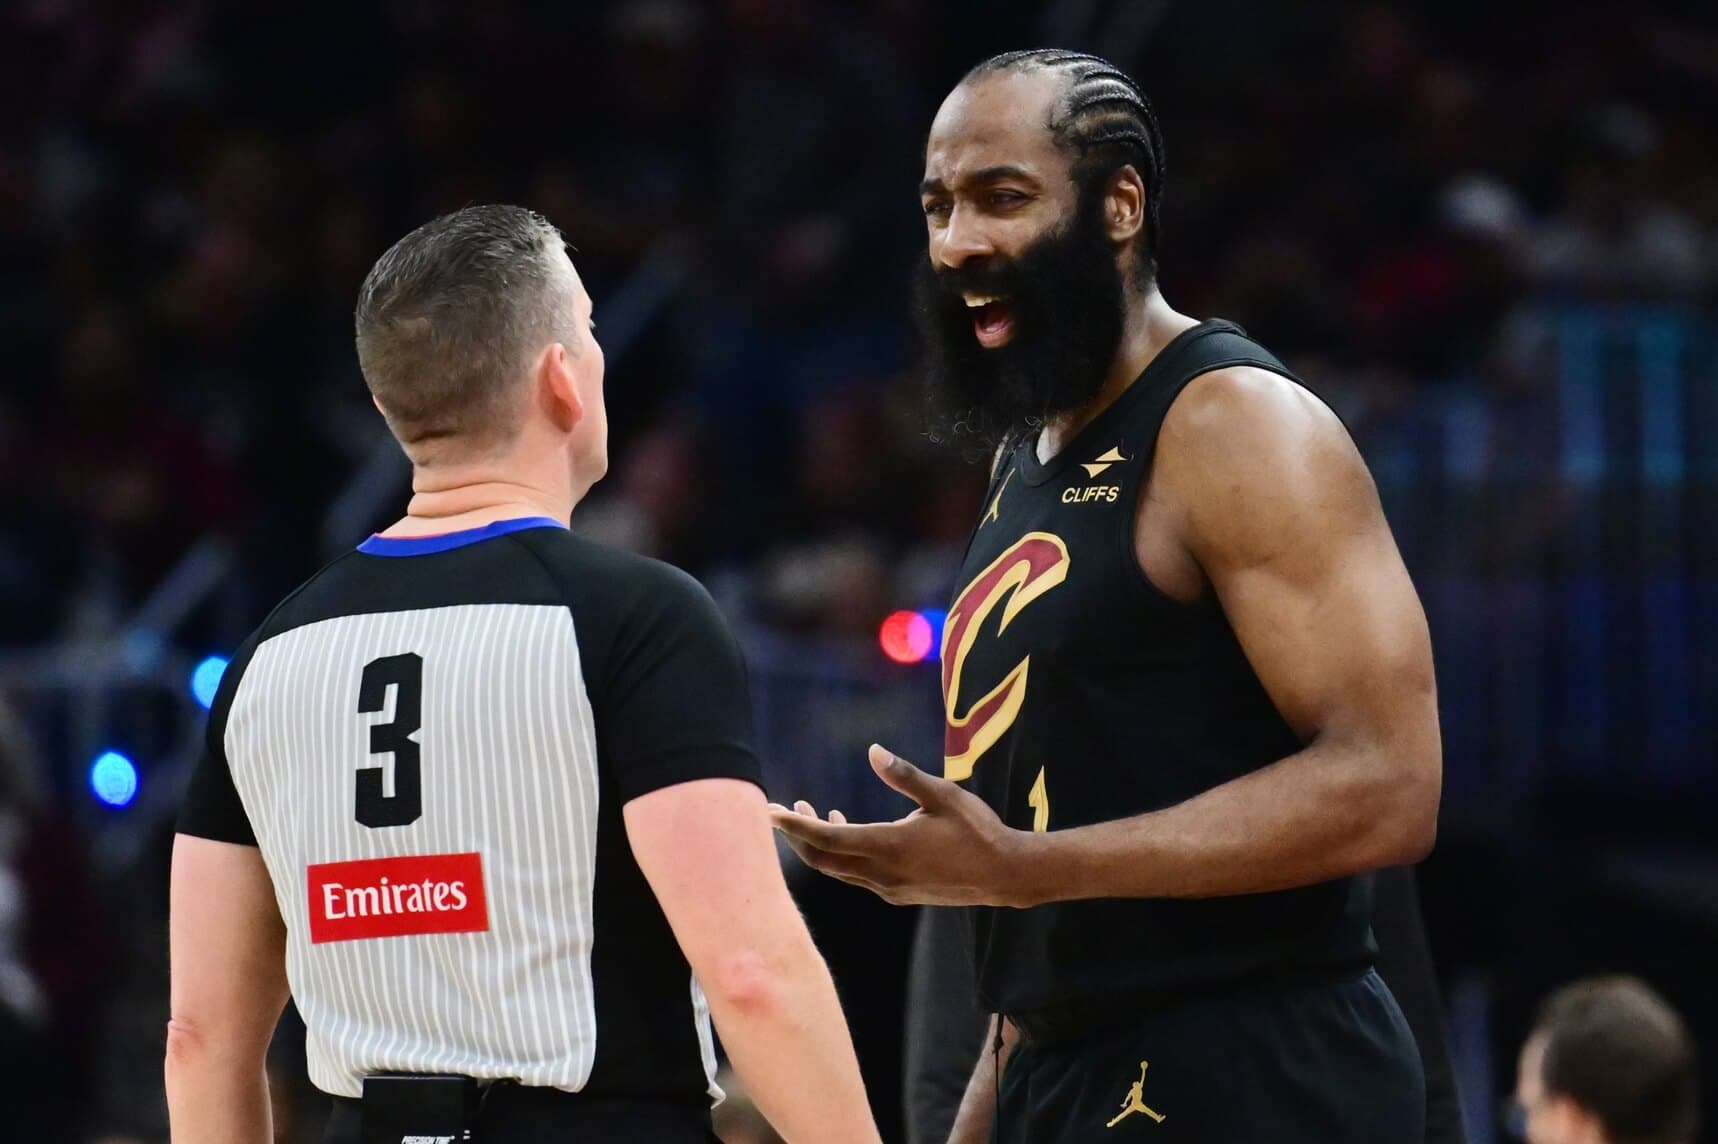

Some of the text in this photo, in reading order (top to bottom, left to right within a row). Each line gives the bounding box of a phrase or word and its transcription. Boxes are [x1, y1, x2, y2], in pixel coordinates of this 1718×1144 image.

[1062, 486, 1119, 503] CLIFFS
[355, 652, 423, 828] 3
[322, 876, 467, 920] Emirates
